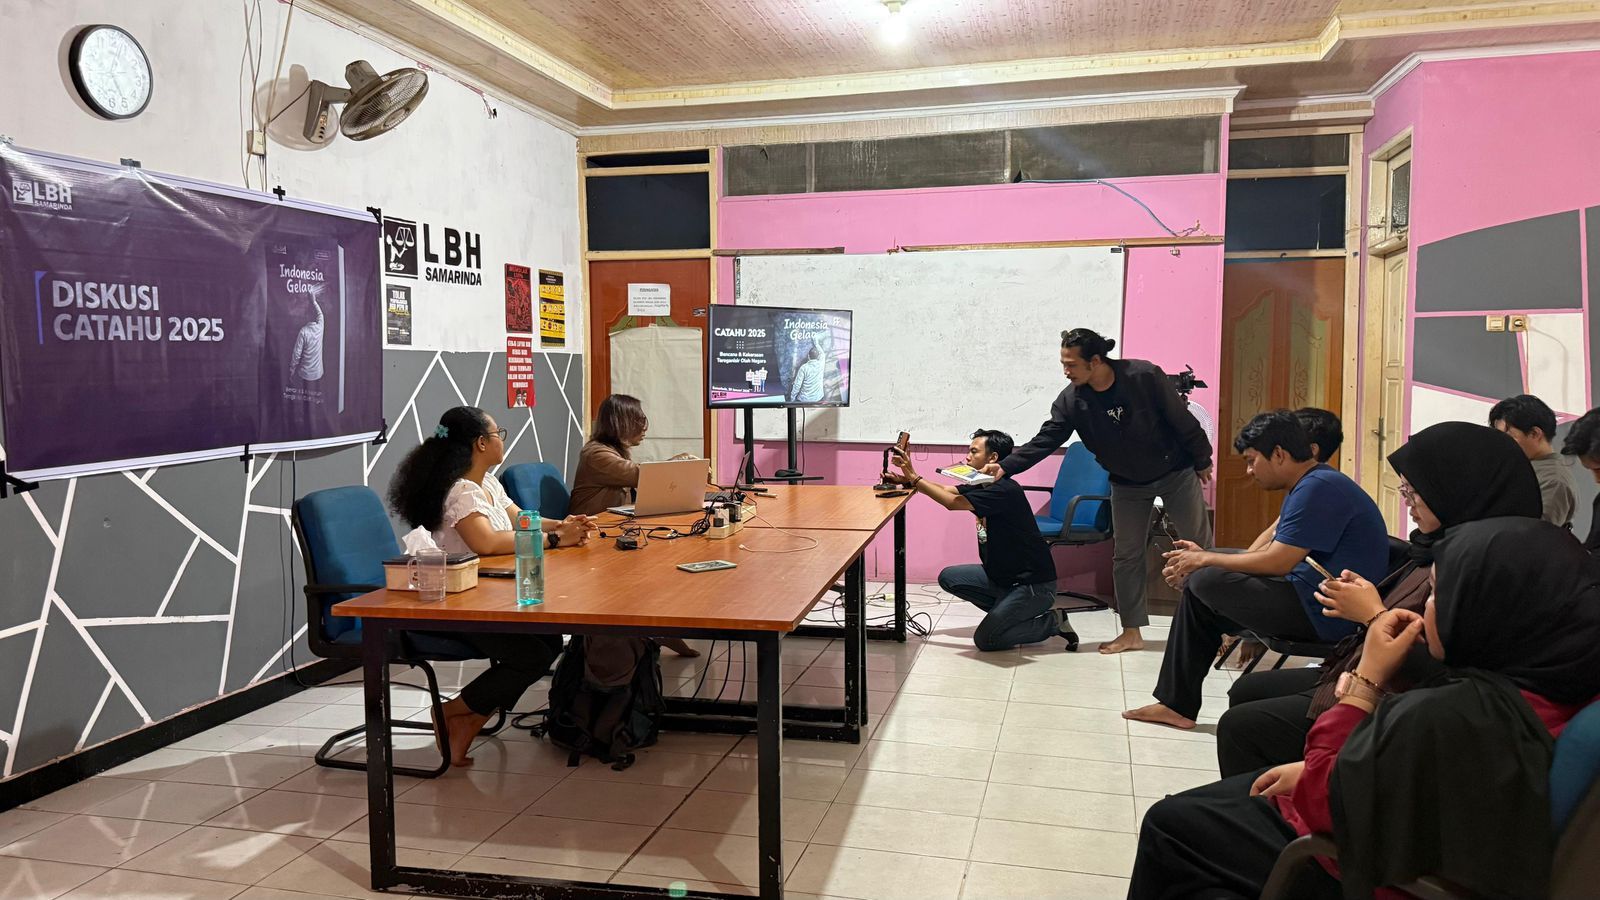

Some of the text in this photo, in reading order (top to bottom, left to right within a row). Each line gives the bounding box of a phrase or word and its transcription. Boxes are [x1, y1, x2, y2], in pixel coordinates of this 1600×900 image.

[33, 181, 72, 203] LBH
[34, 200, 73, 210] SAMARINDA
[423, 223, 481, 269] LBH
[280, 263, 324, 281] Indonesia
[425, 266, 482, 286] SAMARINDA
[52, 280, 160, 311] DISKUSI
[53, 313, 224, 342] CATAHU 2025
[714, 327, 766, 338] CATAHU 2025
[783, 318, 828, 330] Indonesia
